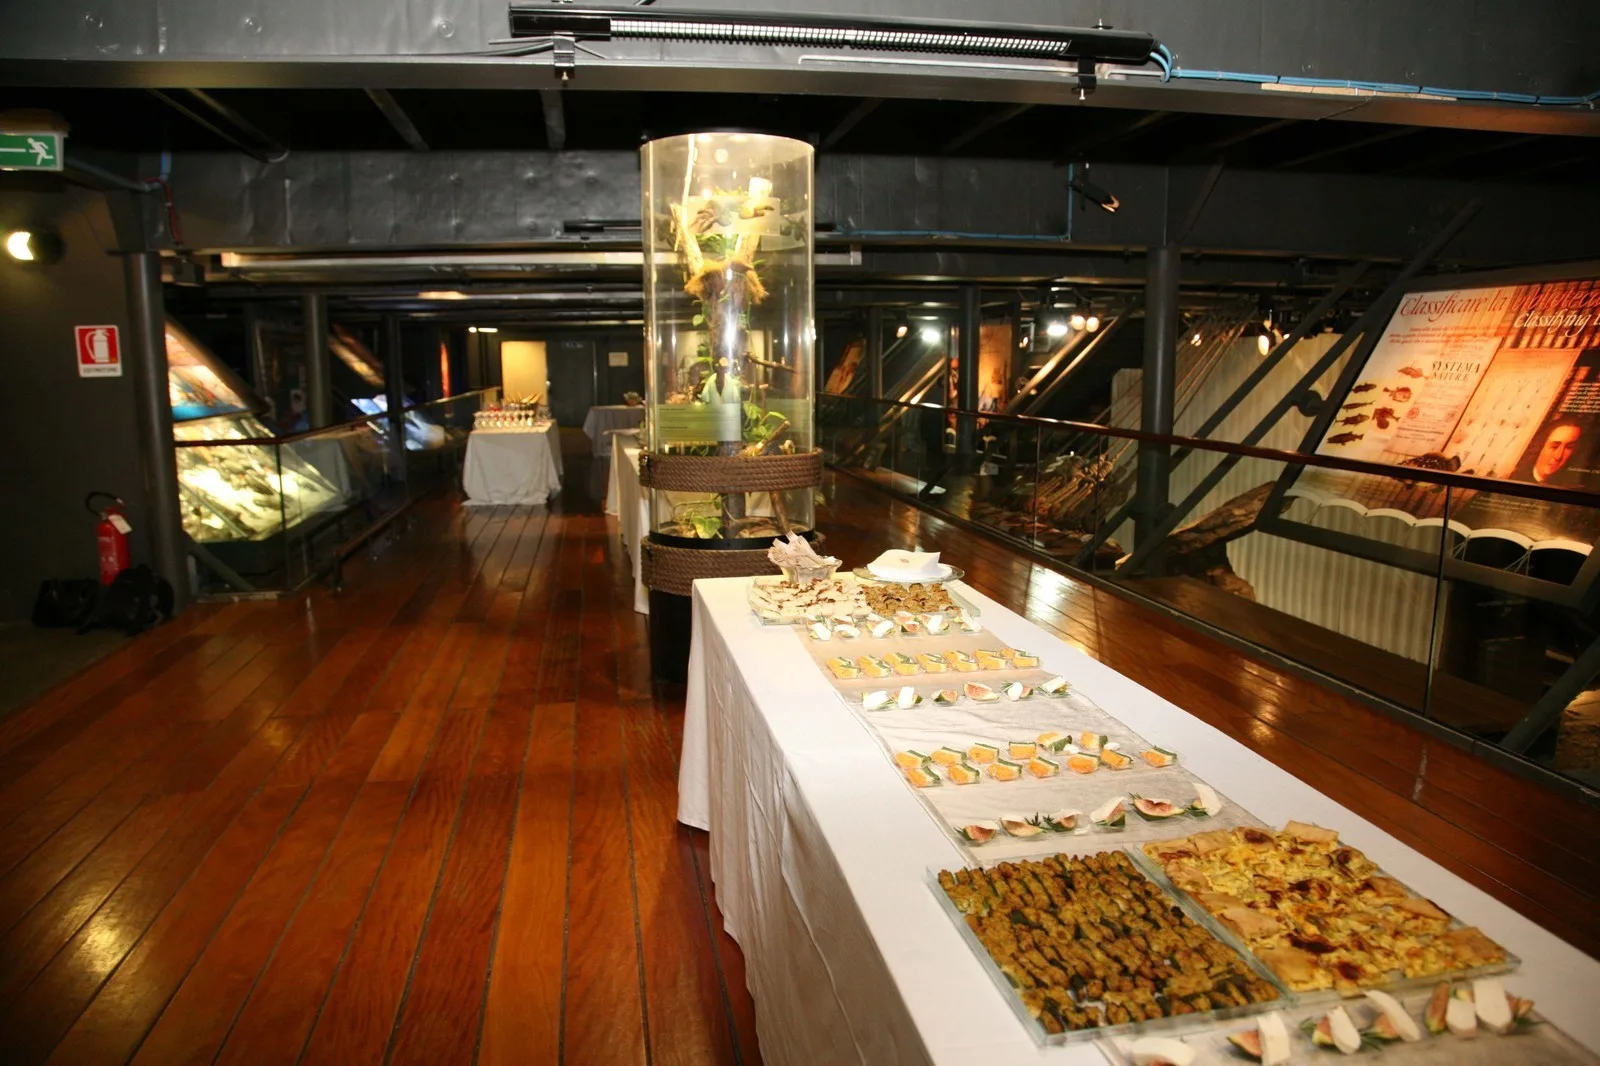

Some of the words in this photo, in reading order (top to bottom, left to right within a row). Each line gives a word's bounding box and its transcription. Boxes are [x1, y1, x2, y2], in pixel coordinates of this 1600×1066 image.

[1400, 292, 1487, 323] Classificare
[1488, 290, 1508, 313] la
[1514, 309, 1592, 338] Classifying
[1432, 361, 1480, 374] SYSTEMA
